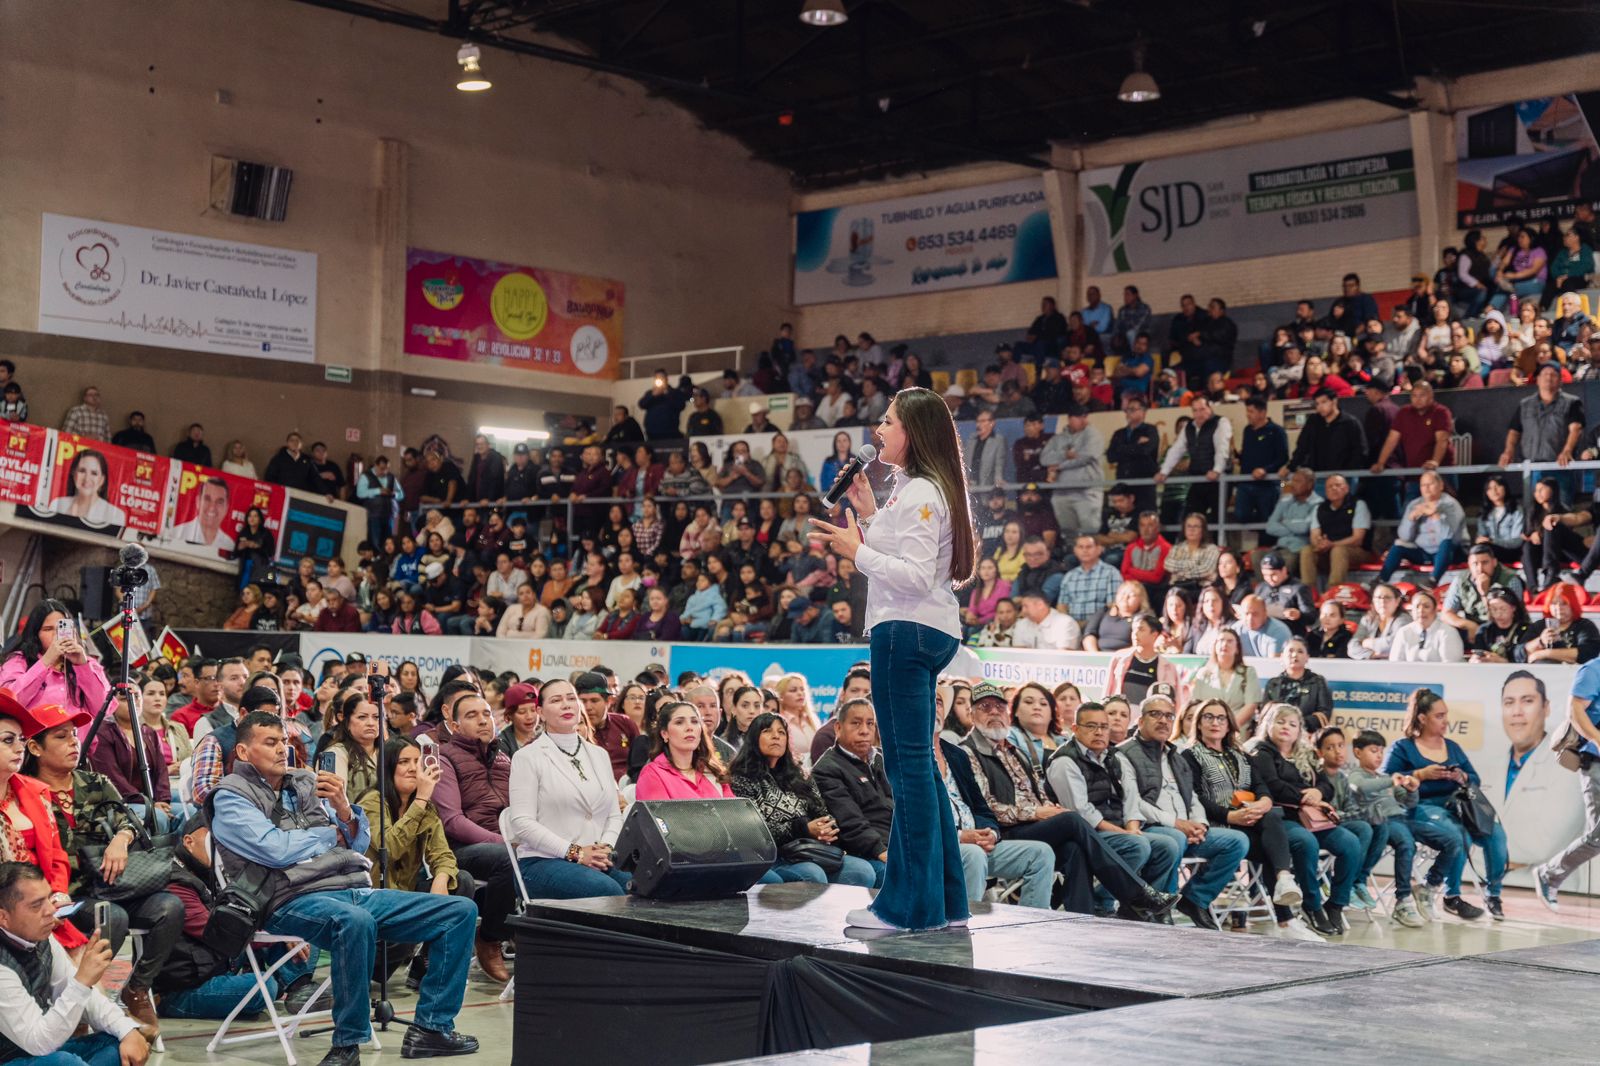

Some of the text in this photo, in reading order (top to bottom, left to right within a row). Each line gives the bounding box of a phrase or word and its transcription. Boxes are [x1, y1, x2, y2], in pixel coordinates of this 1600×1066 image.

[1328, 165, 1335, 178] Y
[936, 206, 943, 217] Y
[944, 199, 977, 216] AGUA
[978, 191, 1046, 212] PURIFICADA
[1139, 182, 1204, 242] SJD
[140, 270, 308, 307] Dr. Javier Castañeda López
[9, 435, 27, 451] PT
[136, 464, 153, 480] PT
[120, 484, 160, 502] CELIDA
[253, 493, 269, 508] PT
[120, 494, 157, 513] LÓPEZ
[542, 654, 568, 667] LOVAL
[1024, 666, 1030, 679] Y
[1332, 690, 1348, 701] DR.
[1349, 691, 1385, 703] SERGIO
[1387, 693, 1402, 703] DE
[1335, 717, 1405, 733] PACIENT
